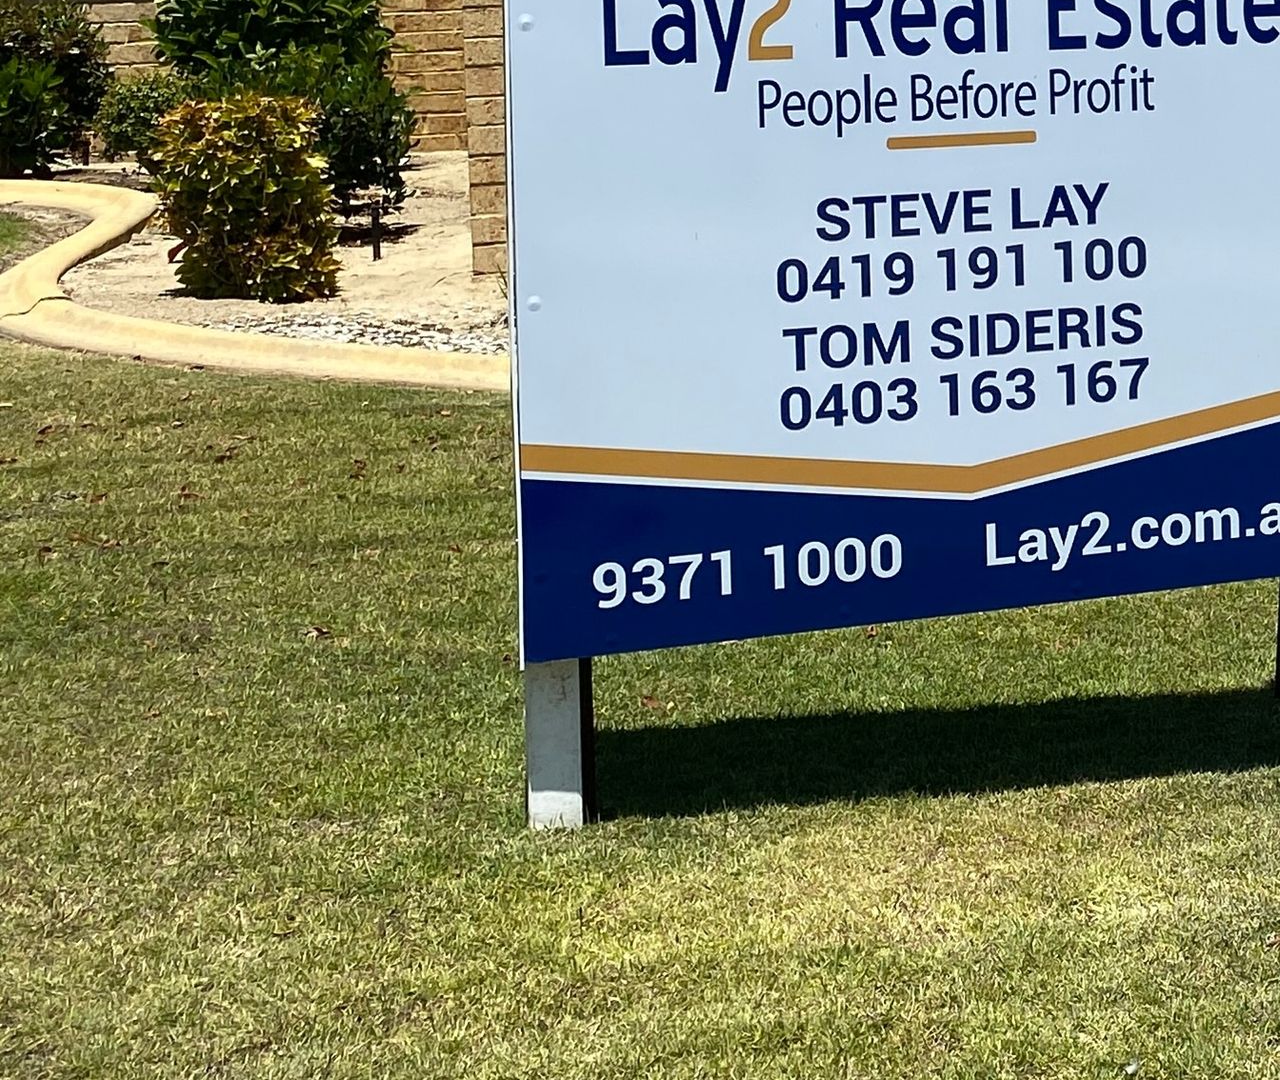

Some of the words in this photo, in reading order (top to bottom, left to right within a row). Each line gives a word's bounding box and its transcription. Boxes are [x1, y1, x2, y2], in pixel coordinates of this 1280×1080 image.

[758, 74, 897, 137] People
[910, 69, 1037, 122] Before
[1049, 63, 1155, 115] Profit
[816, 190, 993, 242] STEVE
[1011, 183, 1110, 229] LAY
[776, 251, 914, 303] 0419
[936, 243, 1025, 291] 191
[1054, 236, 1147, 282] 100
[783, 320, 911, 372] TOM
[930, 302, 1143, 360] SIDERIS
[780, 377, 918, 430] 0403
[939, 367, 1036, 417] 163
[1056, 357, 1149, 406] 167
[592, 550, 732, 609] 9371
[764, 533, 902, 590] 1000
